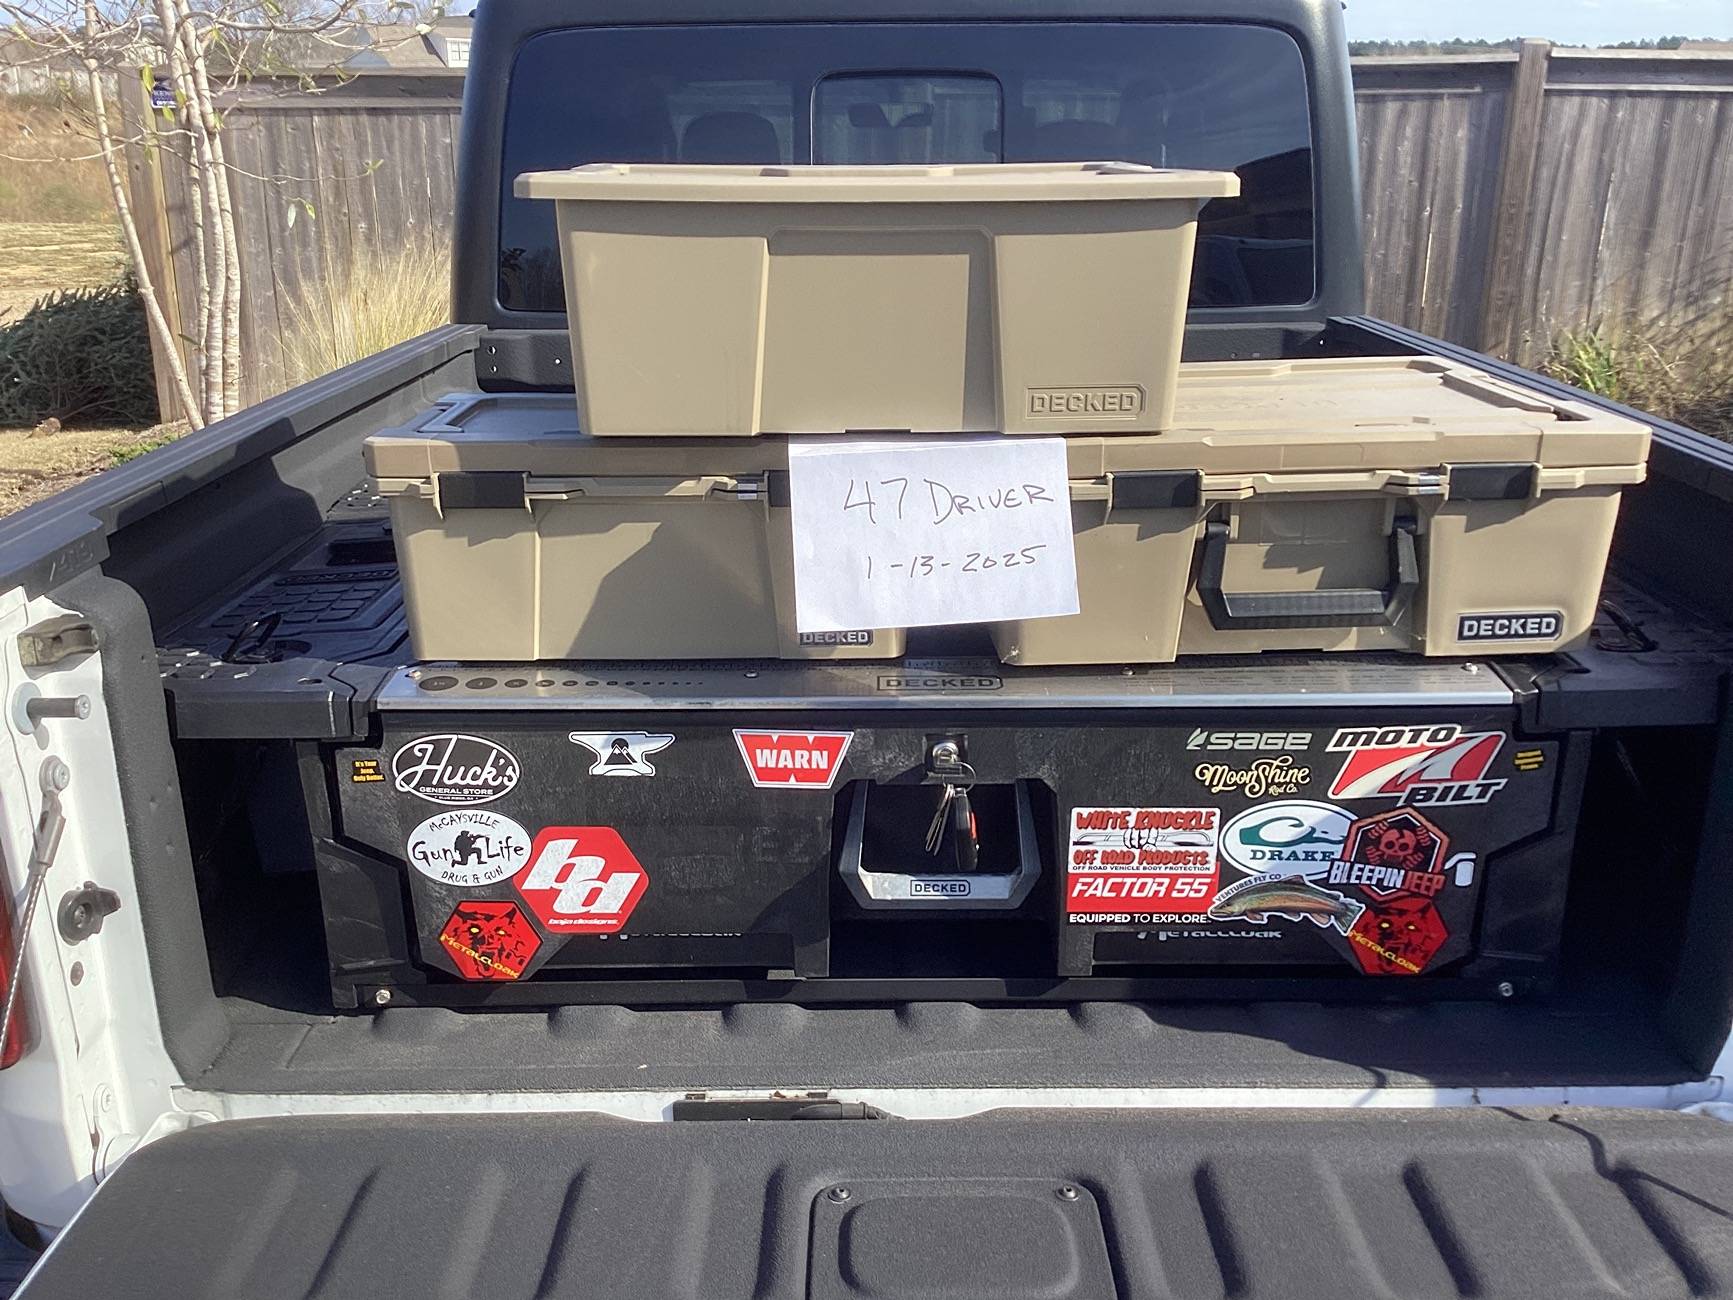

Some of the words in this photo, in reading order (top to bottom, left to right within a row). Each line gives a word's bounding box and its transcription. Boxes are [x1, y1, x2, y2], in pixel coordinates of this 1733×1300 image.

[1030, 392, 1138, 413] DECKED
[843, 478, 909, 525] 47
[1463, 617, 1556, 636] DECKED
[802, 631, 868, 644] DECKED
[886, 678, 994, 688] DECKED
[395, 735, 518, 792] Huck's
[755, 748, 828, 769] WARN
[419, 786, 461, 795] GENERAL
[1403, 782, 1502, 802] BILT
[1076, 810, 1132, 830] WHITE
[1132, 810, 1217, 831] KNUCKLE
[412, 841, 454, 867] Gun
[485, 836, 524, 861] Life
[1073, 850, 1099, 866] OFF
[1100, 850, 1136, 866] ROAD
[1138, 850, 1209, 866] PRODUCTS
[1249, 849, 1335, 862] DRAKE
[441, 870, 468, 884] DRUG
[472, 874, 480, 884] &
[484, 865, 503, 880] GUN
[1254, 874, 1267, 882] FLY
[914, 883, 967, 893] DECKED
[1071, 877, 1170, 898] FACTOR
[1170, 878, 1212, 898] 55
[1069, 914, 1131, 923] EQUIPPED
[1133, 914, 1151, 923] TO
